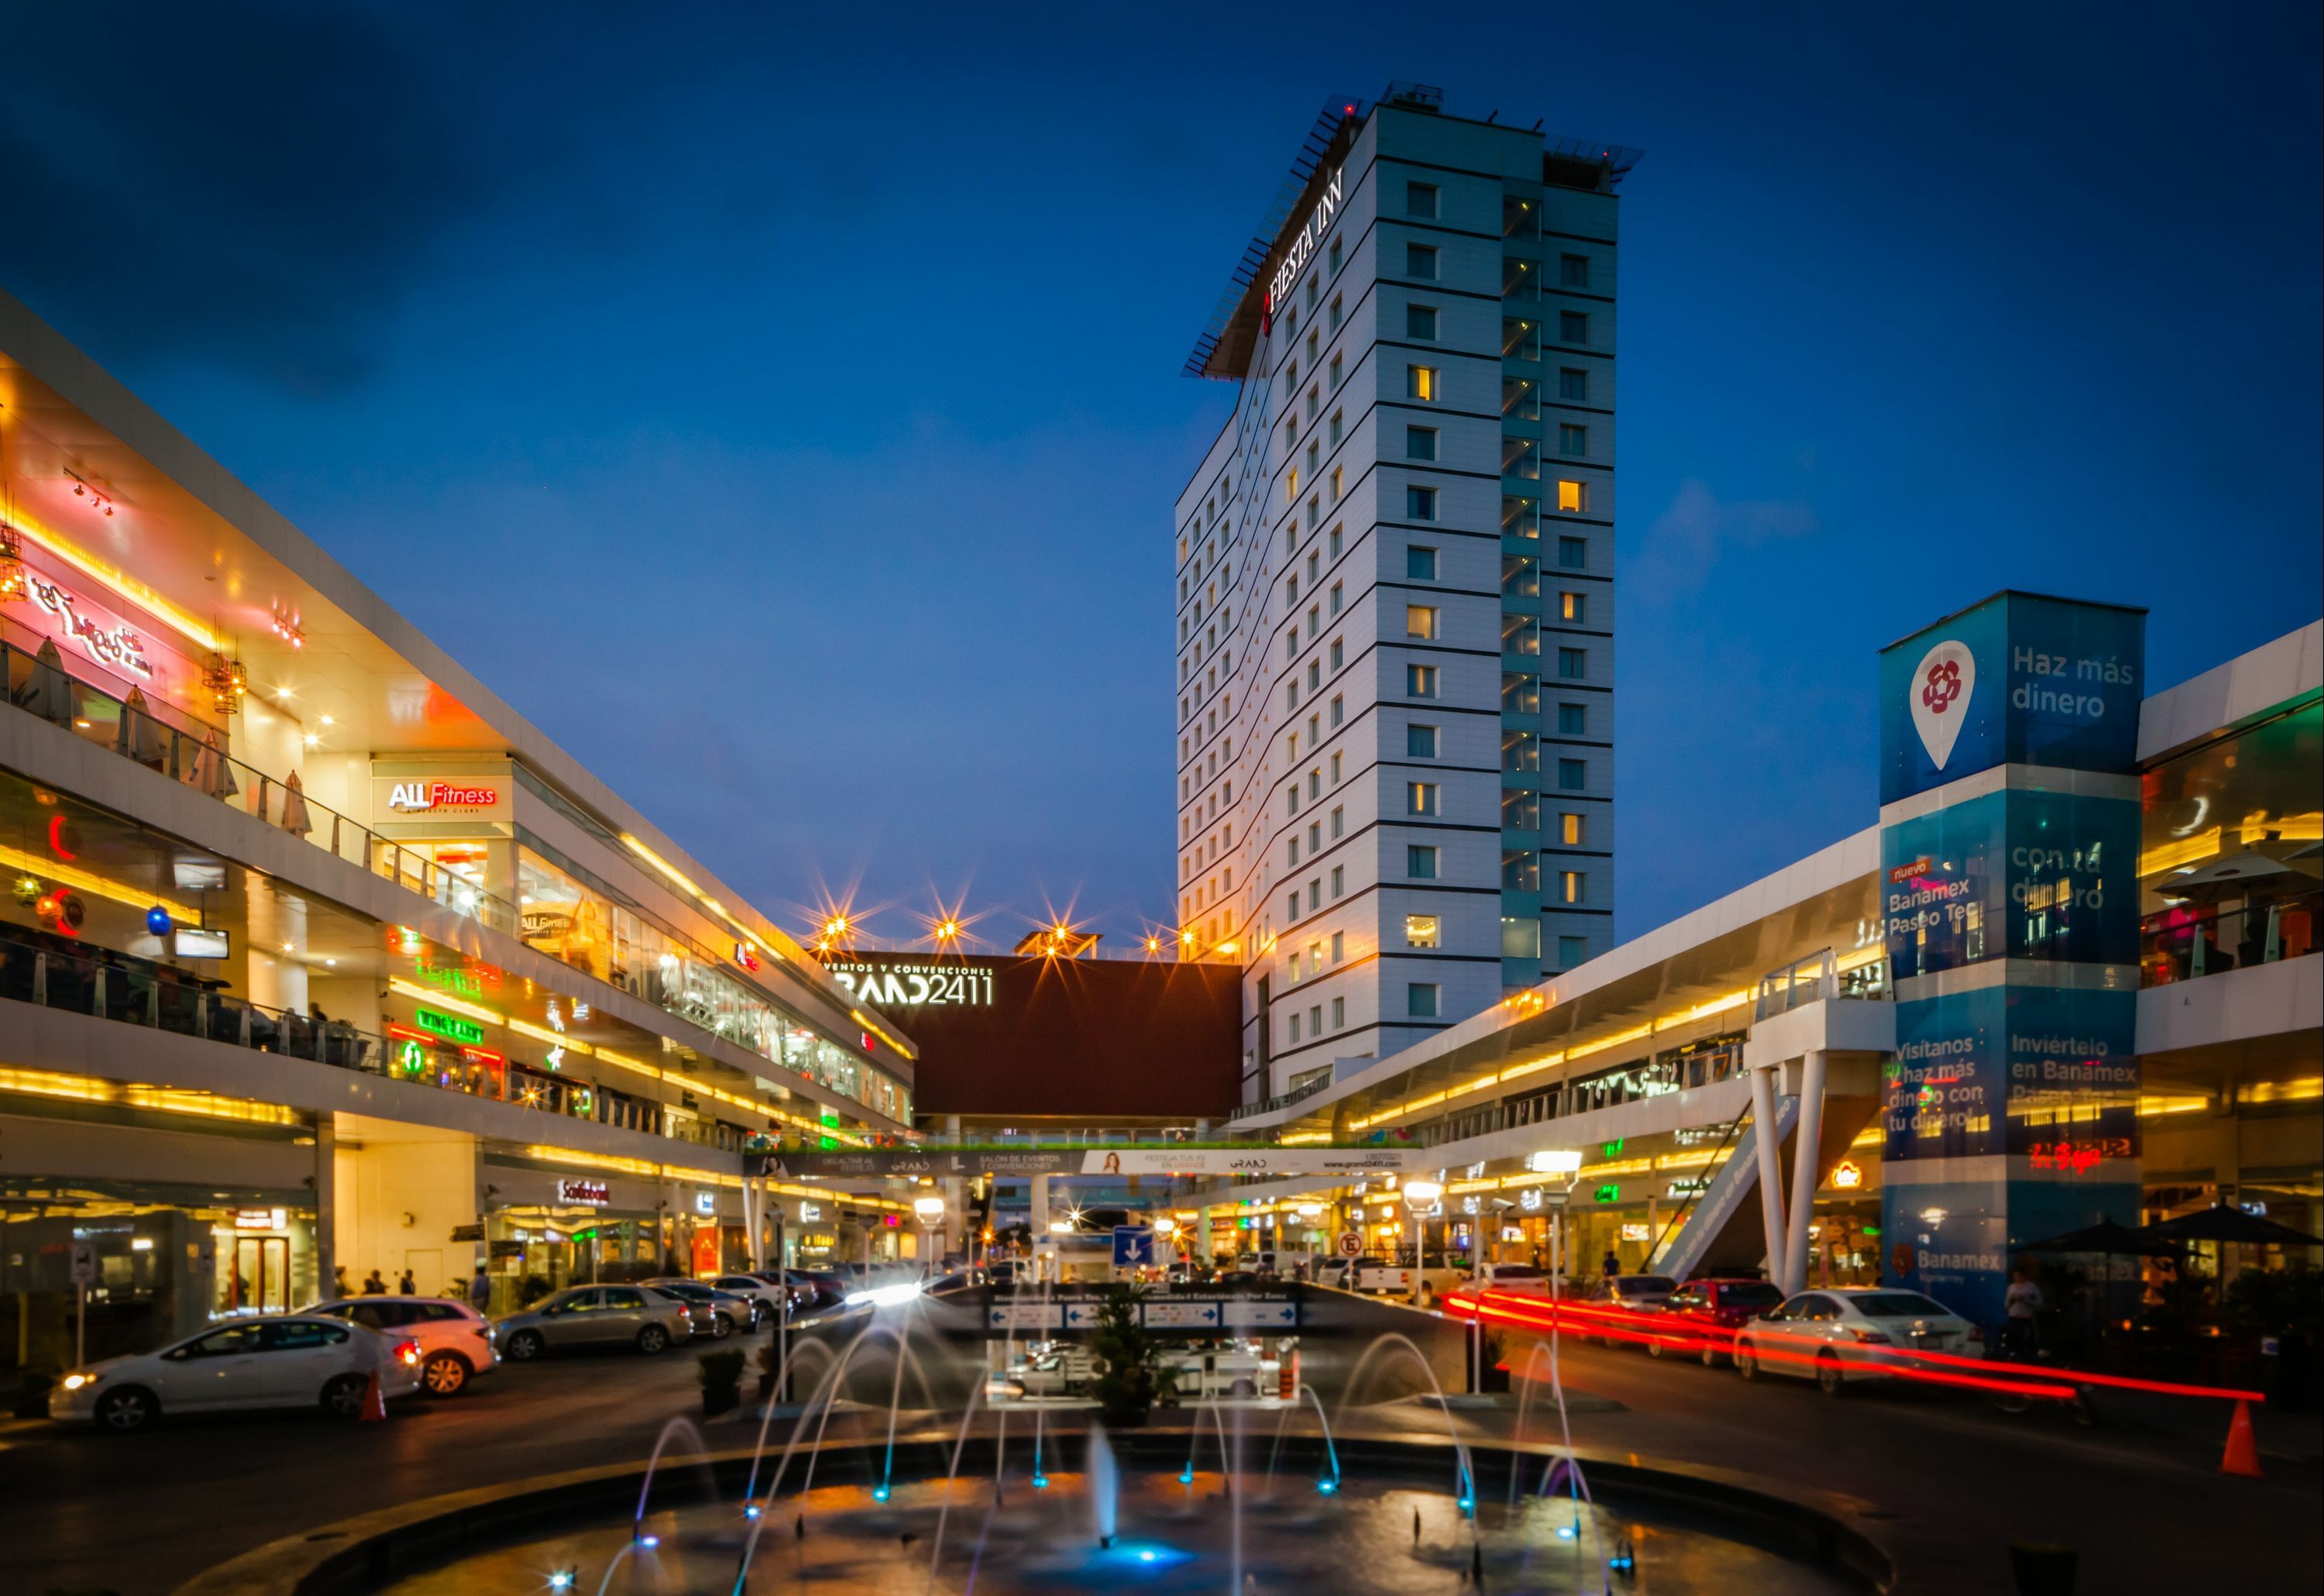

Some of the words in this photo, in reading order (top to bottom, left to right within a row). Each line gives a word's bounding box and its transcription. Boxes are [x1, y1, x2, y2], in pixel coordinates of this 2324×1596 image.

[1269, 222, 1314, 314] FIESTA
[1316, 167, 1345, 236] INN
[2014, 645, 2068, 677] Haz
[2077, 655, 2134, 685] más
[2012, 682, 2105, 717] dinero
[388, 783, 430, 808] ALL
[428, 783, 495, 807] Fitness
[2012, 846, 2064, 870] con
[1894, 862, 1927, 880] nuevo
[1889, 879, 1969, 913] Banamex
[1889, 910, 1941, 936] Paseo
[1944, 901, 1978, 923] Tec
[818, 962, 873, 973] VENTOS
[880, 964, 887, 972] Y
[894, 964, 993, 976] CONVENCIONES
[2012, 1033, 2109, 1057] Inviértelo
[1903, 1065, 1934, 1084] haz
[1938, 1057, 1975, 1080] más
[2011, 1061, 2037, 1078] en
[2044, 1060, 2137, 1083] Banamex
[1889, 1090, 1944, 1109] dino
[1948, 1085, 1983, 1103] con
[1889, 1114, 1906, 1132] tu
[979, 1154, 1008, 1163] SALÓN
[1022, 1154, 1061, 1163] EVENTOS
[1323, 1160, 1402, 1169] www.grand2411.com
[1917, 1249, 2000, 1271] Banamex
